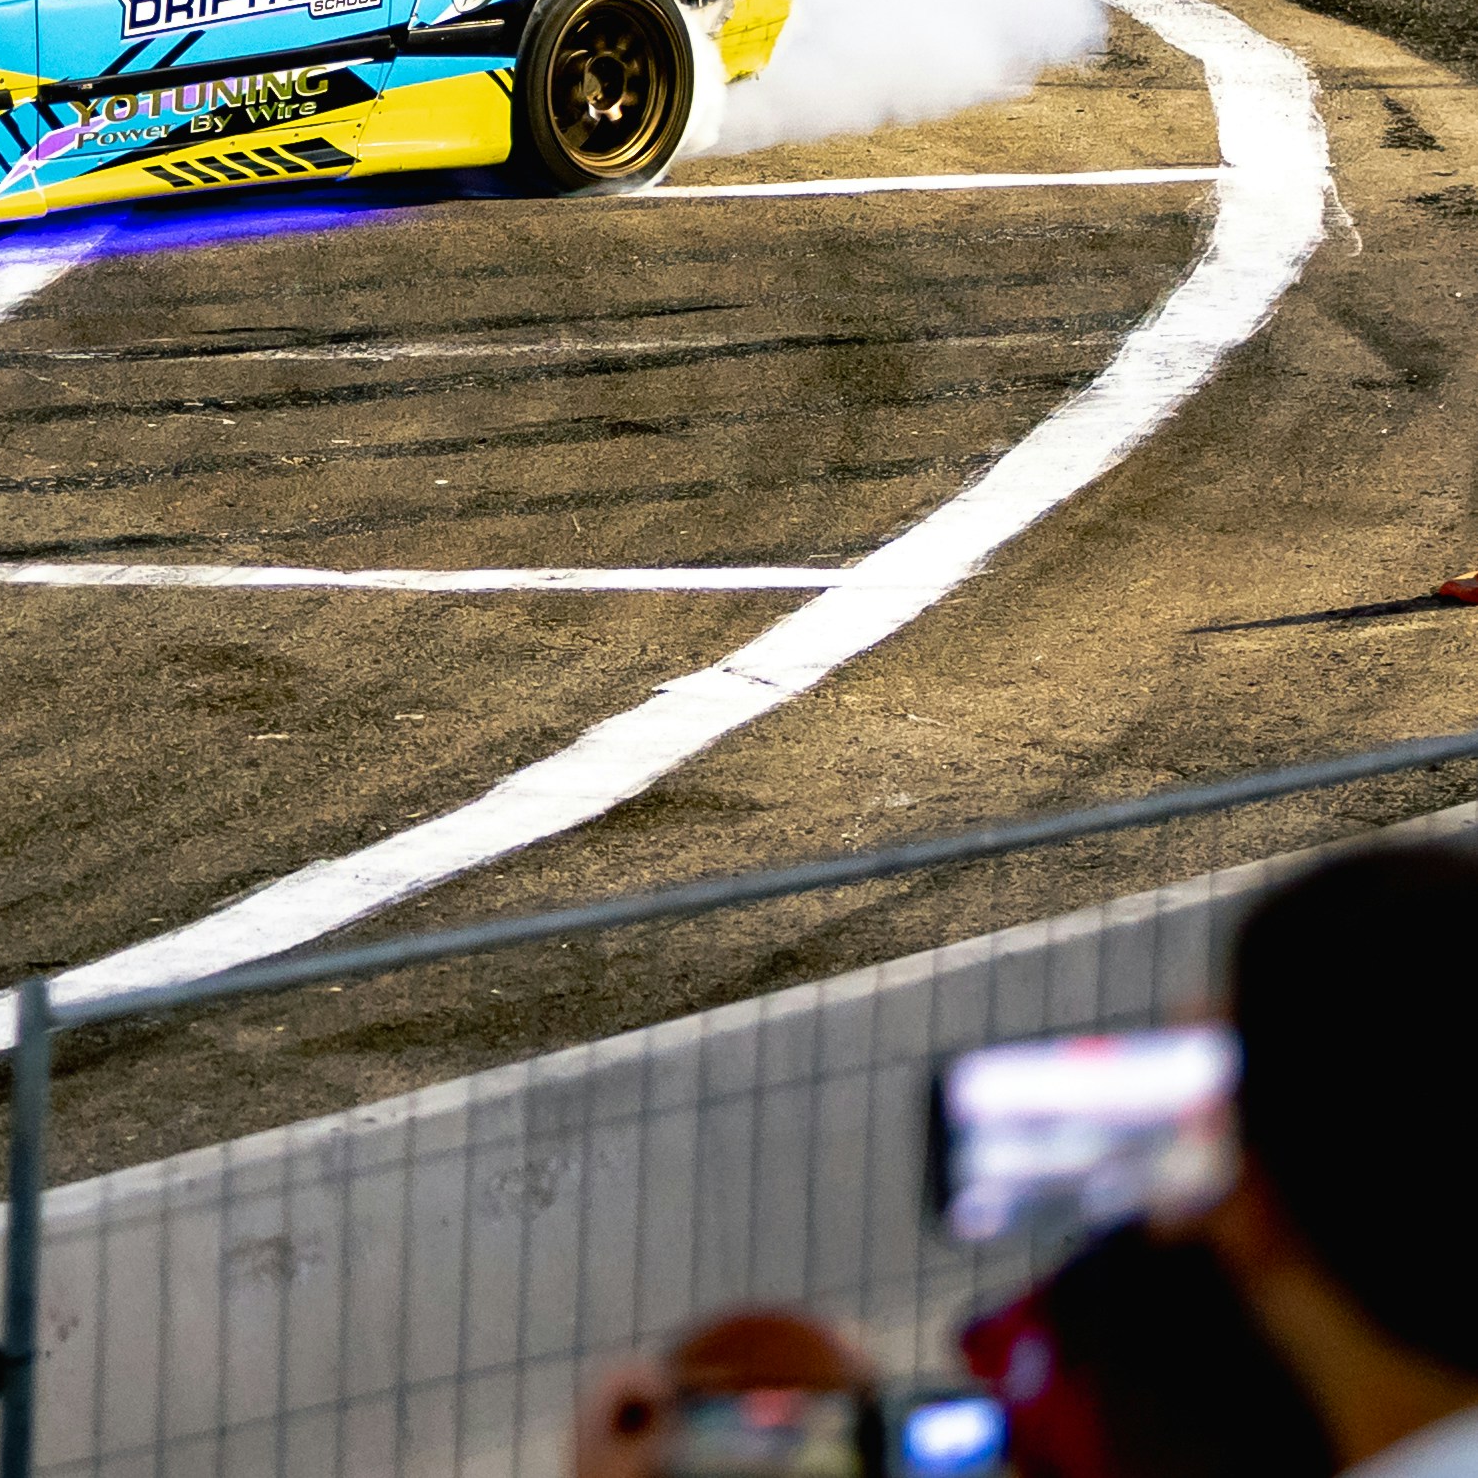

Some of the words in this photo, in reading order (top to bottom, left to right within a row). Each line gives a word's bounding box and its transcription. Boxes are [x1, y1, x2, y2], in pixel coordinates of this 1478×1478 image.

[68, 65, 329, 127] YOTUNING
[74, 122, 174, 150] Power
[190, 111, 233, 134] By
[245, 101, 317, 124] Wire
